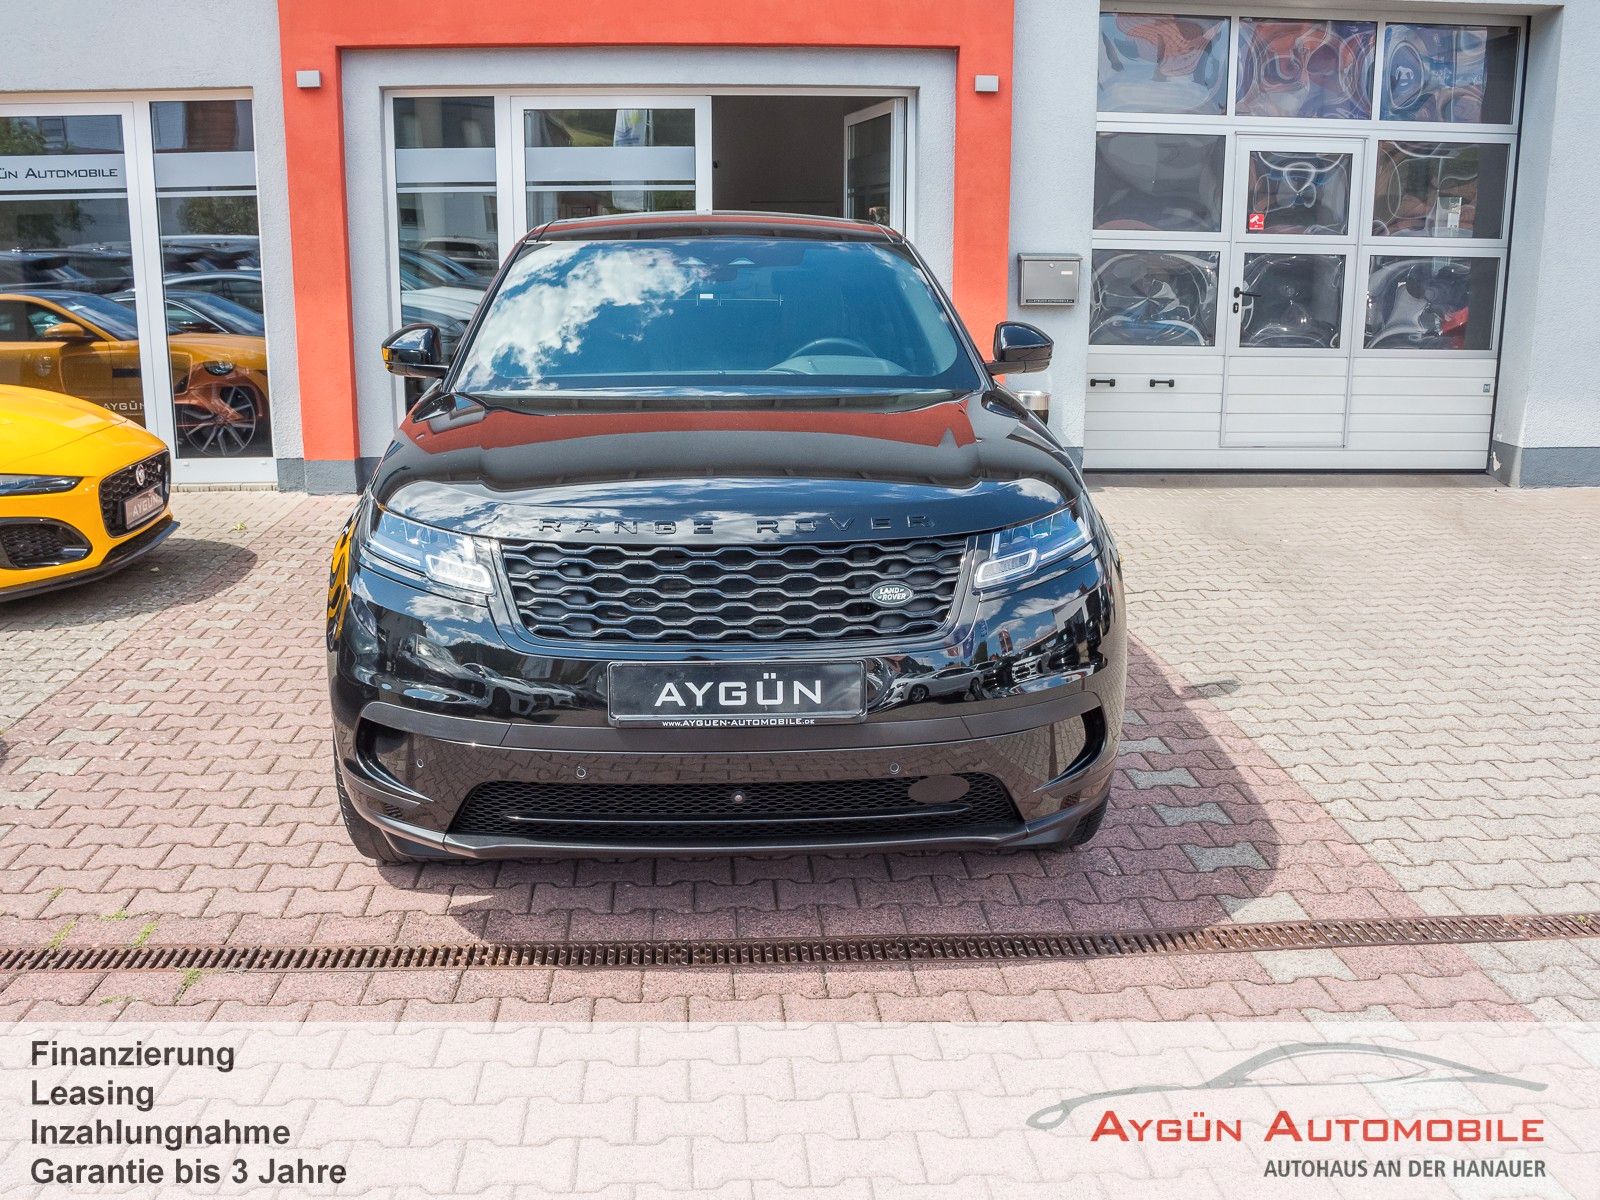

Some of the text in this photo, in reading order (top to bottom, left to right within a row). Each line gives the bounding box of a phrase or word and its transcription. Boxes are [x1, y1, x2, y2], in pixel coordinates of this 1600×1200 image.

[25, 168, 118, 178] AUTOMOBILE
[538, 514, 935, 535] RANGE ROVER
[654, 672, 822, 707] AYGÜN
